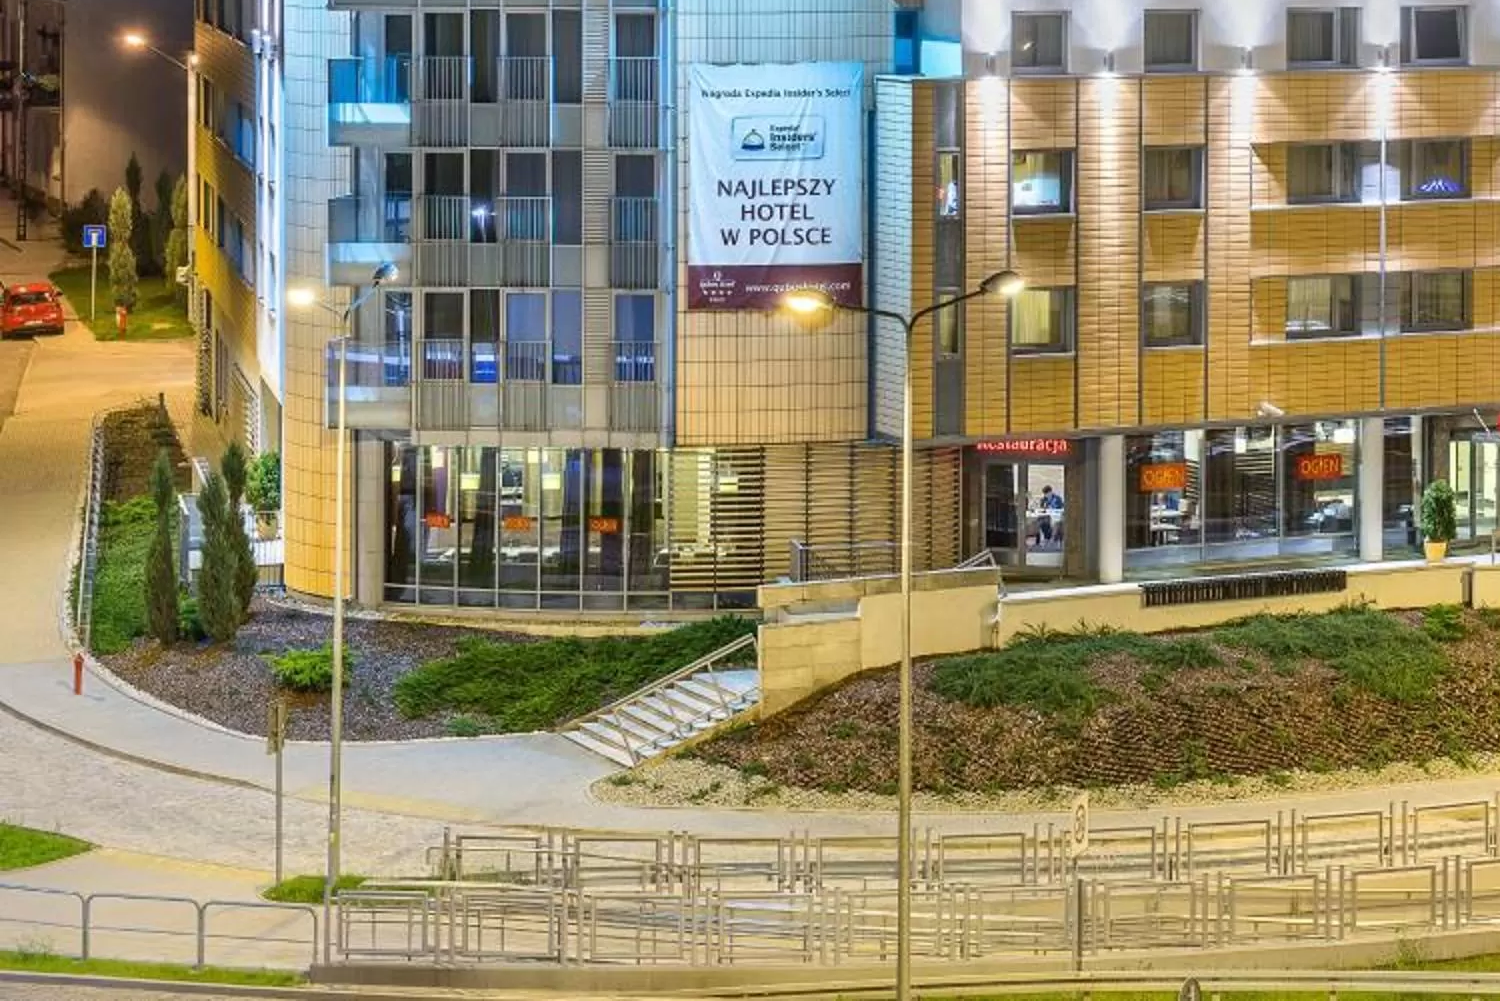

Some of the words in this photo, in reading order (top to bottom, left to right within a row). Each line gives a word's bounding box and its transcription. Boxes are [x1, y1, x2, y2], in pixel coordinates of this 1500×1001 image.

[717, 179, 836, 199] NAJLEPSZY
[741, 204, 814, 221] HOTEL
[720, 229, 740, 246] W
[750, 227, 832, 245] POLSCE
